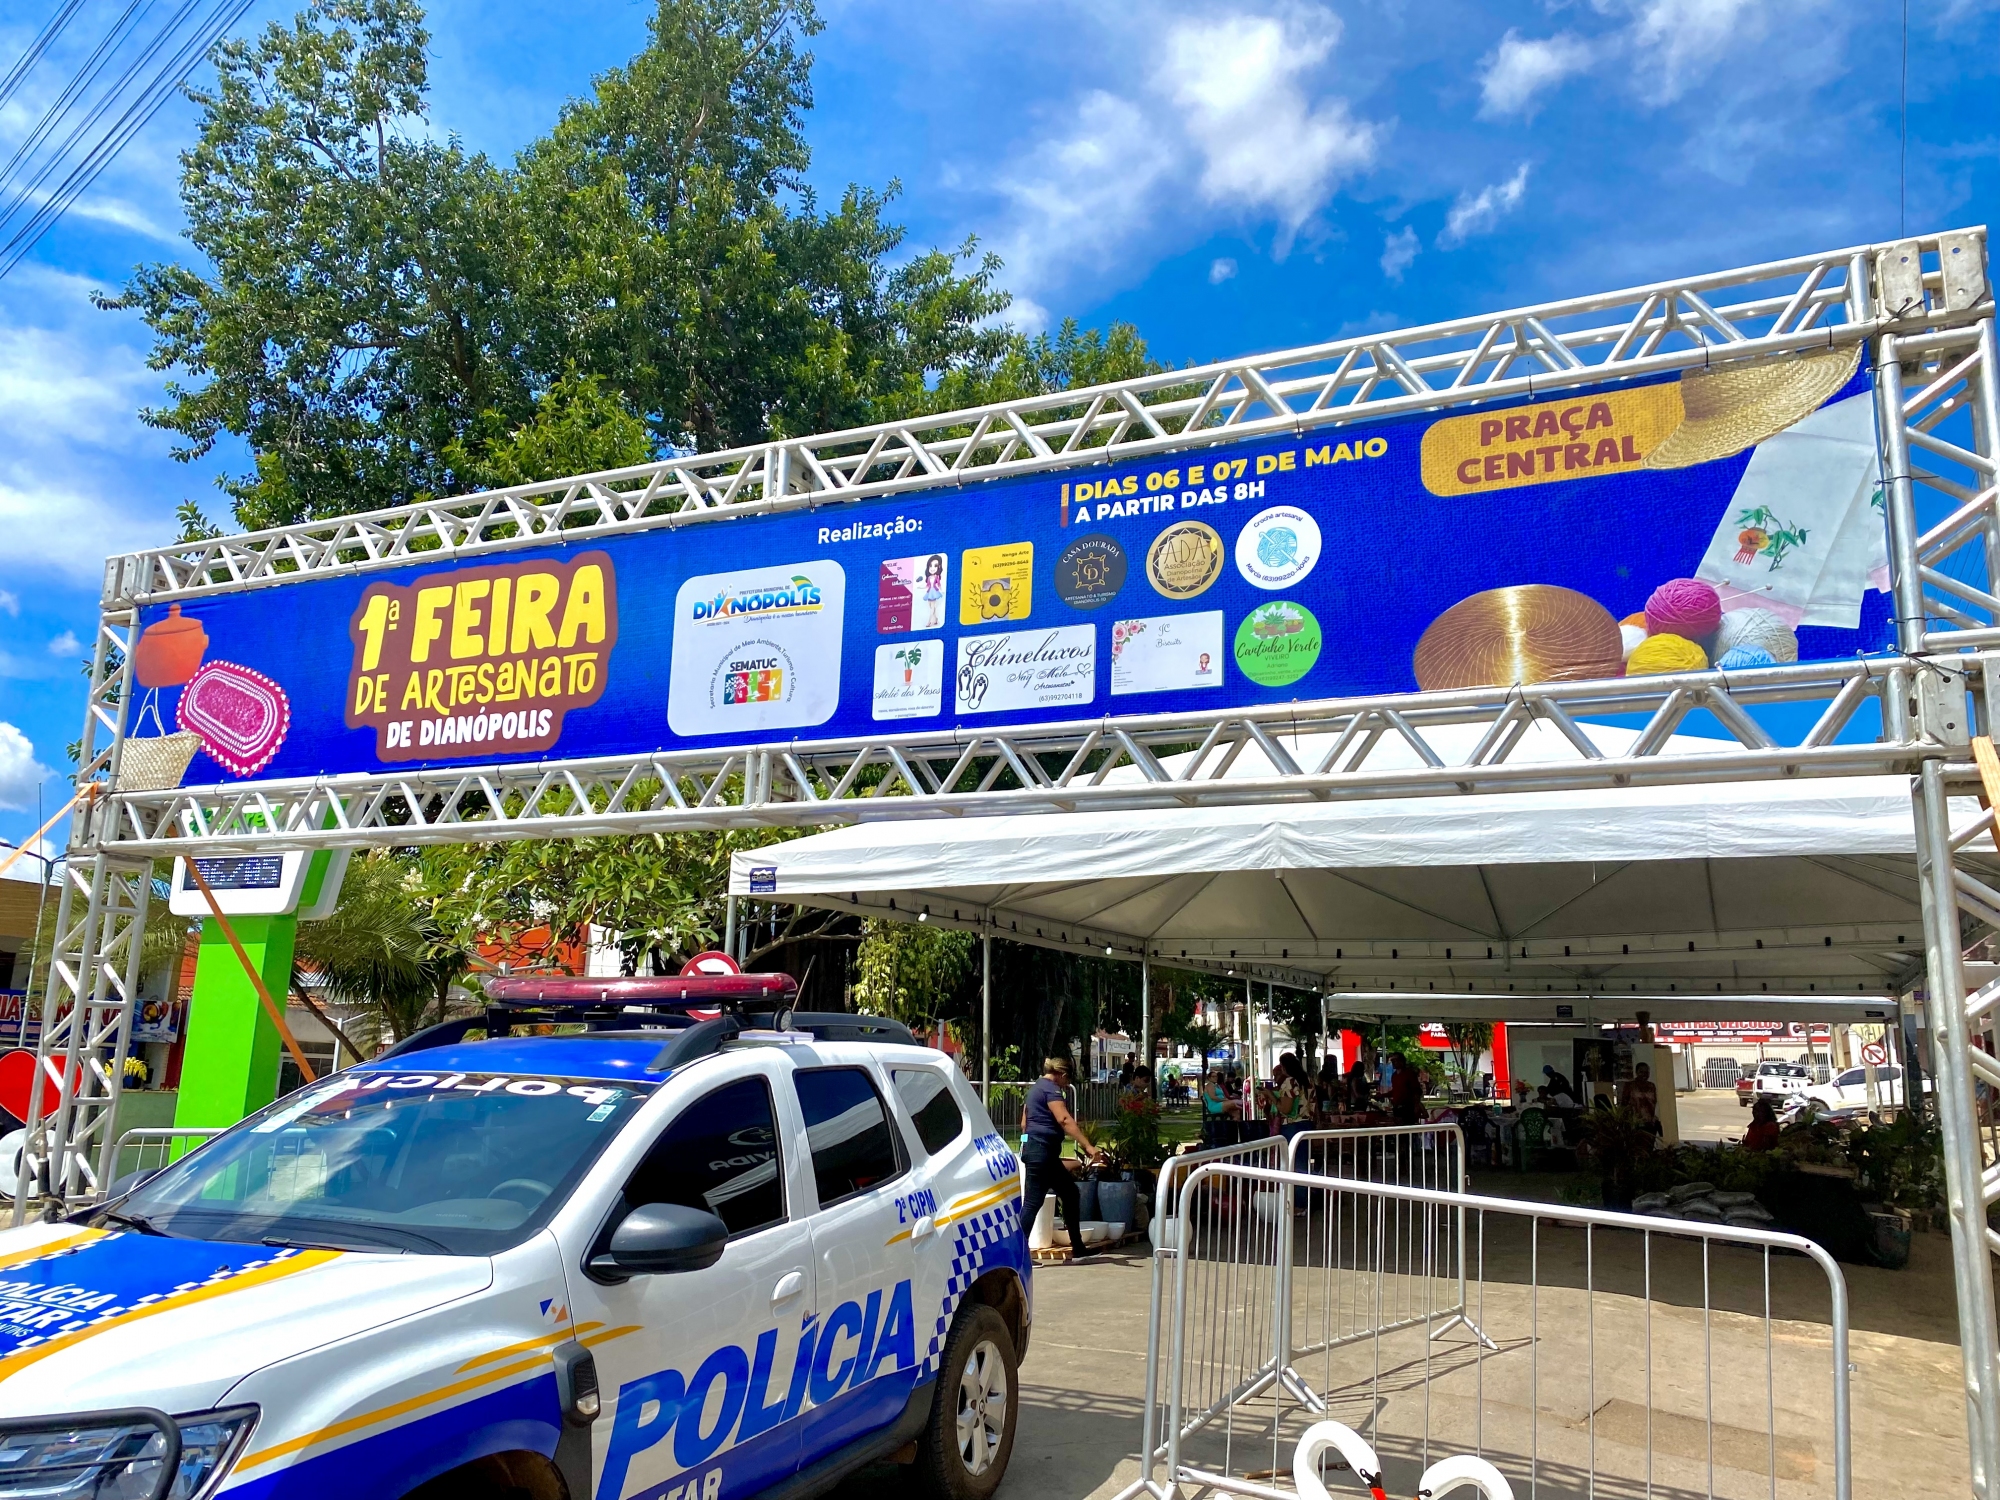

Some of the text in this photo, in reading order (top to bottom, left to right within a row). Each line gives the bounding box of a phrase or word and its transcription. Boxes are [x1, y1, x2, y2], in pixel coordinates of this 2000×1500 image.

[1480, 401, 1614, 446] PRAÇA
[1074, 437, 1388, 502] DIAS 06 E 07 DE MAIO
[1457, 435, 1642, 484] CENTRAL
[1074, 480, 1265, 524] A PARTIR DAS 8H
[818, 515, 923, 544] Realização:
[1062, 541, 1120, 564] CASA DOURADA
[1163, 537, 1206, 564] ADA
[1164, 560, 1206, 570] Associação
[358, 564, 606, 672] 1ª FEIRA
[729, 657, 778, 672] SEMATUC
[966, 631, 1092, 669] Chineluxos
[1236, 635, 1320, 658] Cantinho Verde
[354, 673, 391, 715] DE
[901, 684, 915, 698] dos
[917, 683, 941, 696] Vasos
[386, 706, 553, 749] DE DIANÓPOLIS
[992, 1150, 1016, 1178] 190
[894, 1188, 938, 1224] 2ª CIPM
[594, 1279, 917, 1500] POLÍCIA
